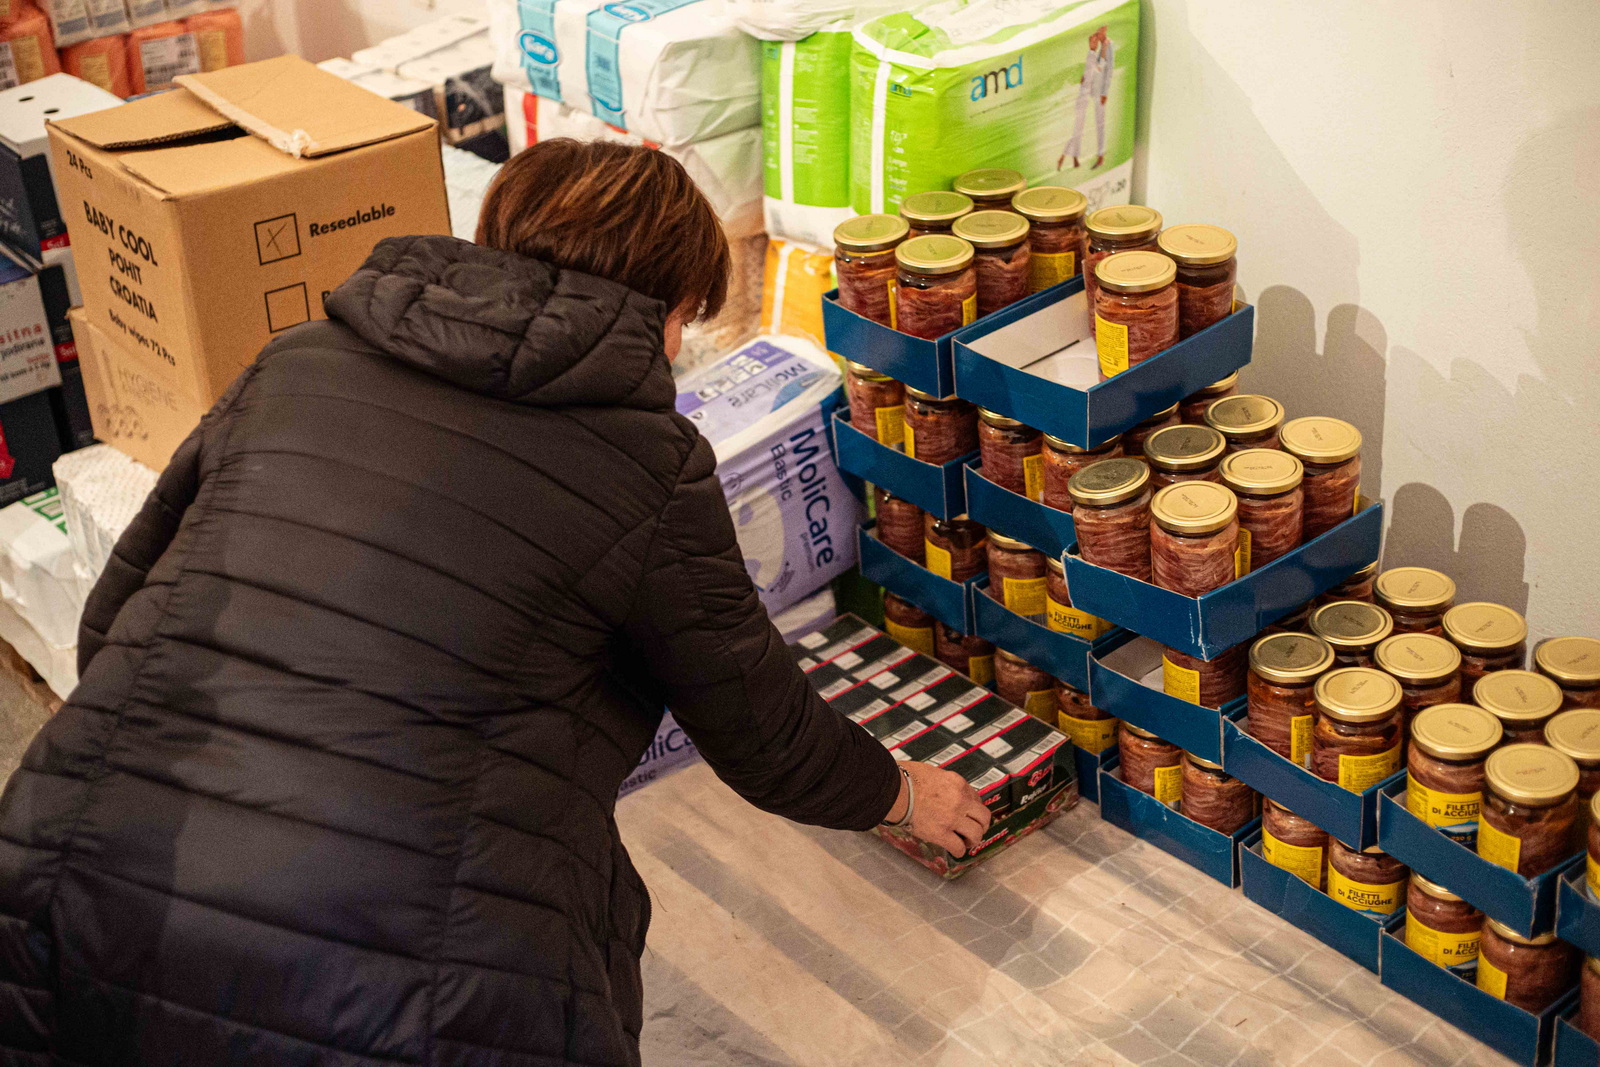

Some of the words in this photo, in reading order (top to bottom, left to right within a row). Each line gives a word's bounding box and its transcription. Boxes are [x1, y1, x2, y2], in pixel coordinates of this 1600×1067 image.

[970, 54, 1023, 101] amd
[66, 149, 79, 169] 24
[79, 157, 93, 179] Pcs
[83, 200, 115, 240] BABY
[119, 224, 158, 267] COOL
[309, 203, 395, 237] Resealable
[109, 275, 158, 323] CROATIA
[770, 443, 793, 502] Elastic
[789, 428, 834, 568] MoliCare
[1053, 617, 1093, 630] ACCIUGHE
[1055, 611, 1080, 623] FILETTI
[1432, 807, 1442, 815] DI
[1337, 888, 1345, 897] DI
[1347, 895, 1393, 906] ACCIUGHE
[1348, 889, 1380, 900] FILETTI
